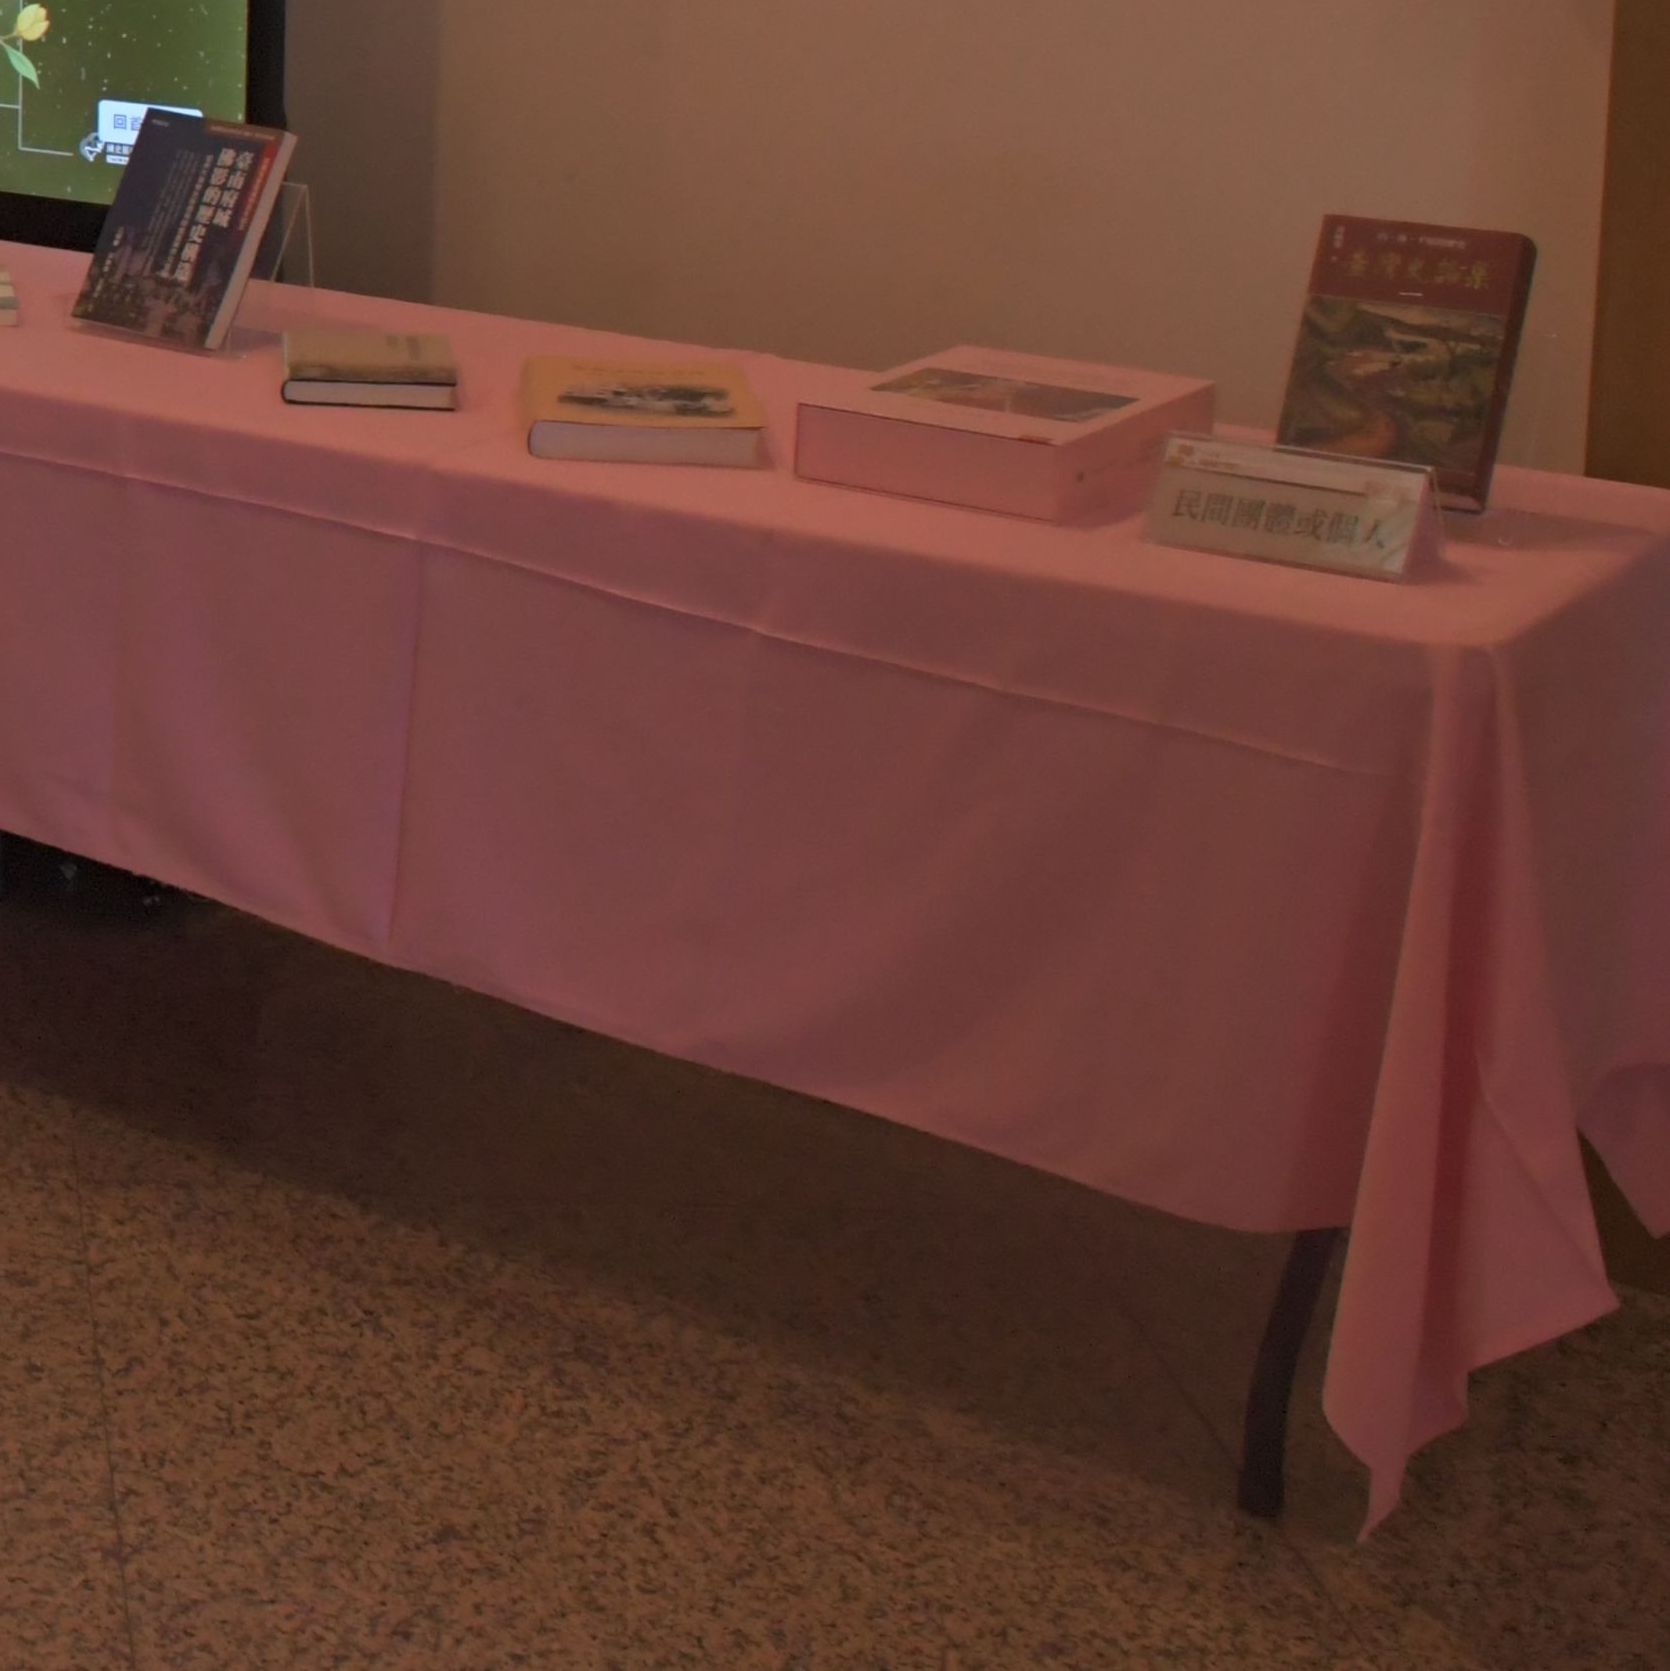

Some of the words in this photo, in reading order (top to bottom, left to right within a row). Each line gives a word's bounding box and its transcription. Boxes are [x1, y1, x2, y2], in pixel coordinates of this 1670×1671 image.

[1172, 489, 1387, 548] 民間團體或個人
